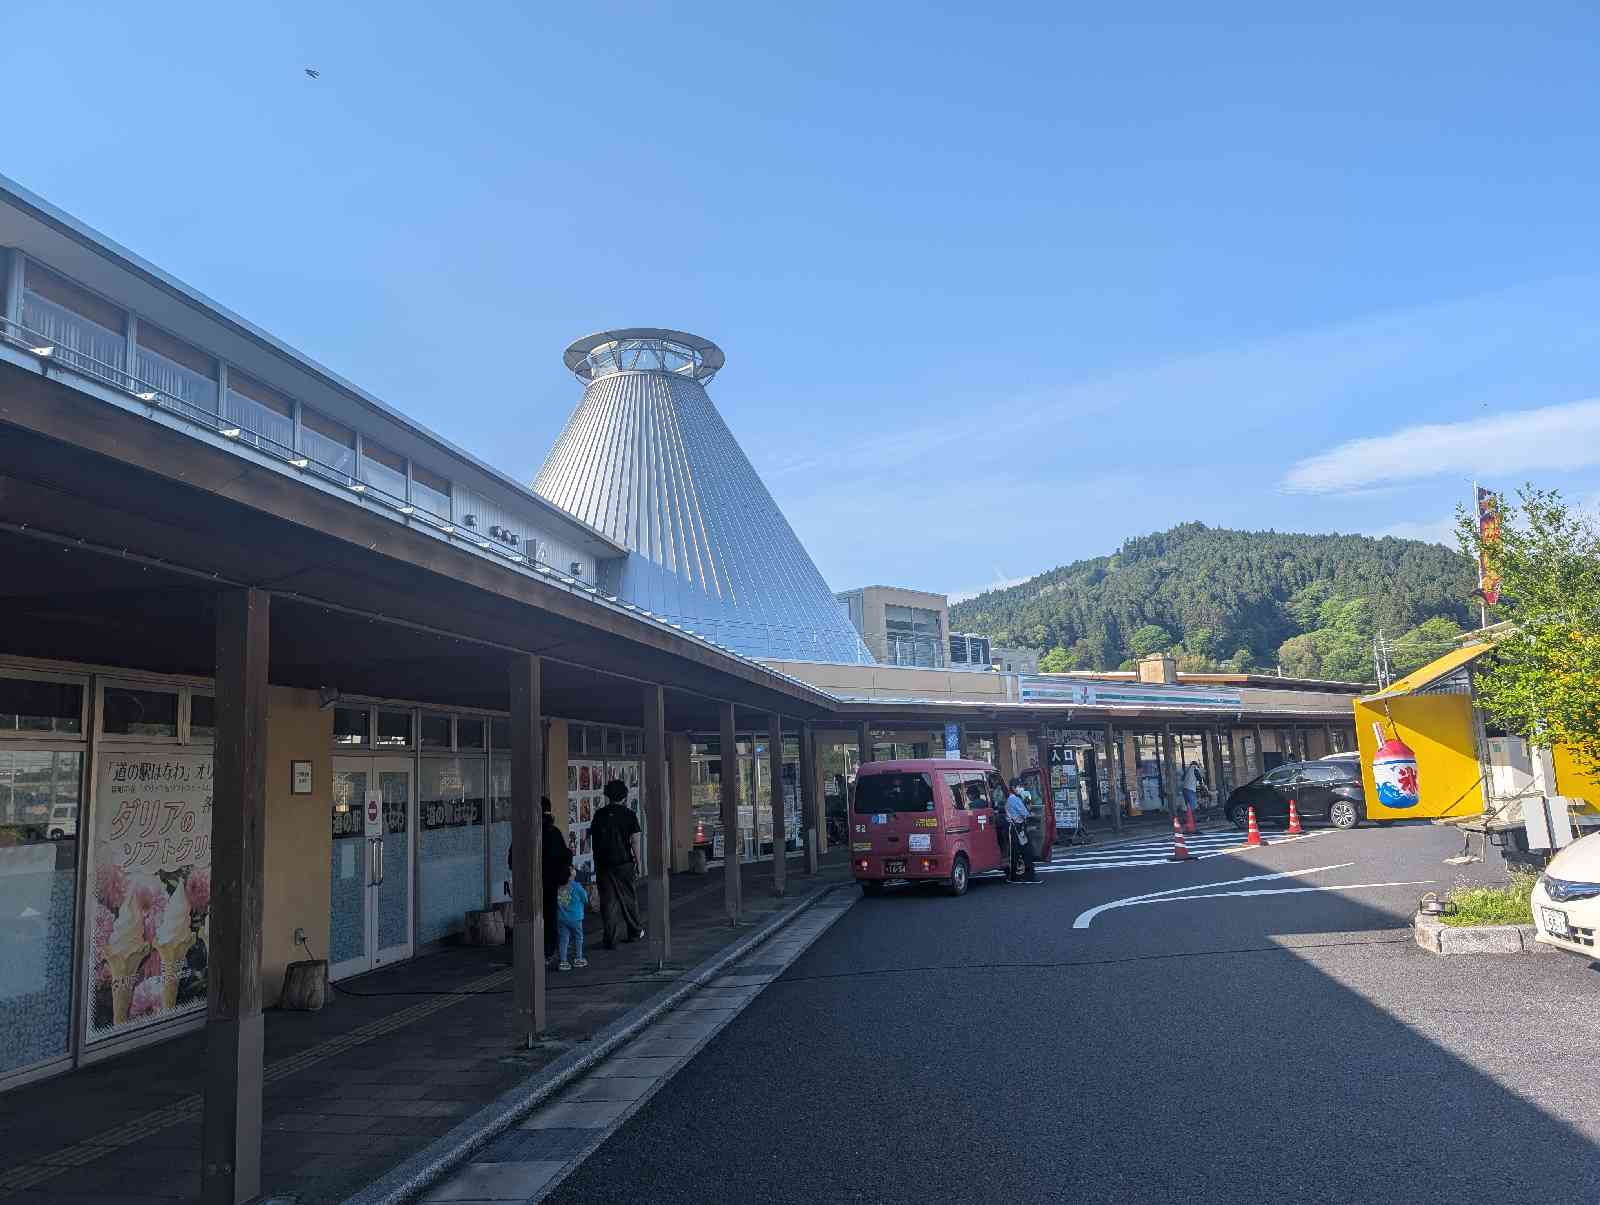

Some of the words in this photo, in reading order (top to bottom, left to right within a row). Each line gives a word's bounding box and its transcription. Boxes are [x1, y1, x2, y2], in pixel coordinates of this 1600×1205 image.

[1051, 749, 1074, 762] 入口
[110, 799, 195, 840] ダリアの
